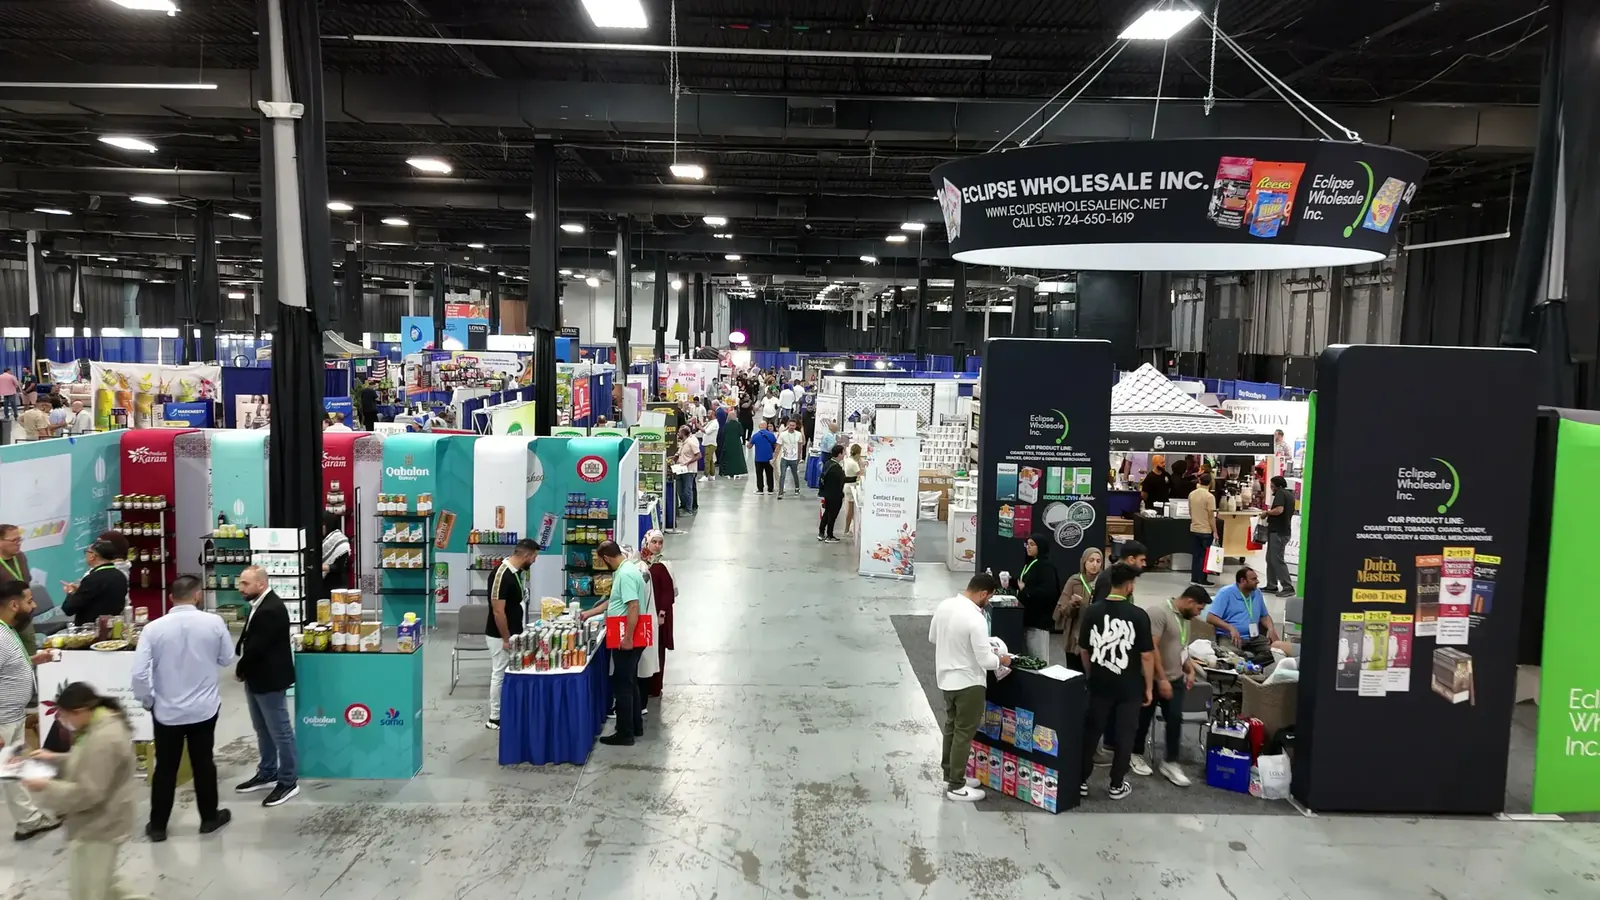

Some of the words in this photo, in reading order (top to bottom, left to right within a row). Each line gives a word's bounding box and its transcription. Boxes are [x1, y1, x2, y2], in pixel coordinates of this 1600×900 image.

[962, 180, 1017, 203] ECLIPSE
[1020, 172, 1153, 196] WHOLESALE
[1160, 171, 1209, 190] INC.
[1313, 174, 1355, 190] Eclipse
[1308, 190, 1364, 205] Wholesale
[985, 198, 1168, 218] WWW.ECLIPSEWHOLESALEINC.NET
[1303, 206, 1324, 220] Inc.
[1012, 216, 1036, 228] CALL
[1037, 215, 1055, 227] US:
[1057, 212, 1135, 226] 724-650-1619
[1030, 414, 1054, 423] Eclipse
[1232, 413, 1289, 425] REMIUM
[1029, 422, 1064, 430] Wholesale
[1233, 440, 1270, 448] coffiyeh.com
[138, 455, 167, 464] Karam
[385, 466, 429, 477] Qabalan
[1398, 467, 1437, 480] Eclipse
[1397, 479, 1452, 490] Wholesale
[1396, 491, 1415, 501] Inc.
[1405, 516, 1444, 524] PRODUCT
[1363, 525, 1403, 533] CIGARETTES,
[1447, 534, 1493, 542] MERCHANDISE
[1363, 558, 1397, 571] Dutch
[1357, 570, 1401, 583] Masters
[1355, 591, 1378, 600] GOOD
[1380, 591, 1403, 600] TIMES
[1569, 687, 1600, 709] Ecl
[303, 715, 336, 724] Qabalan
